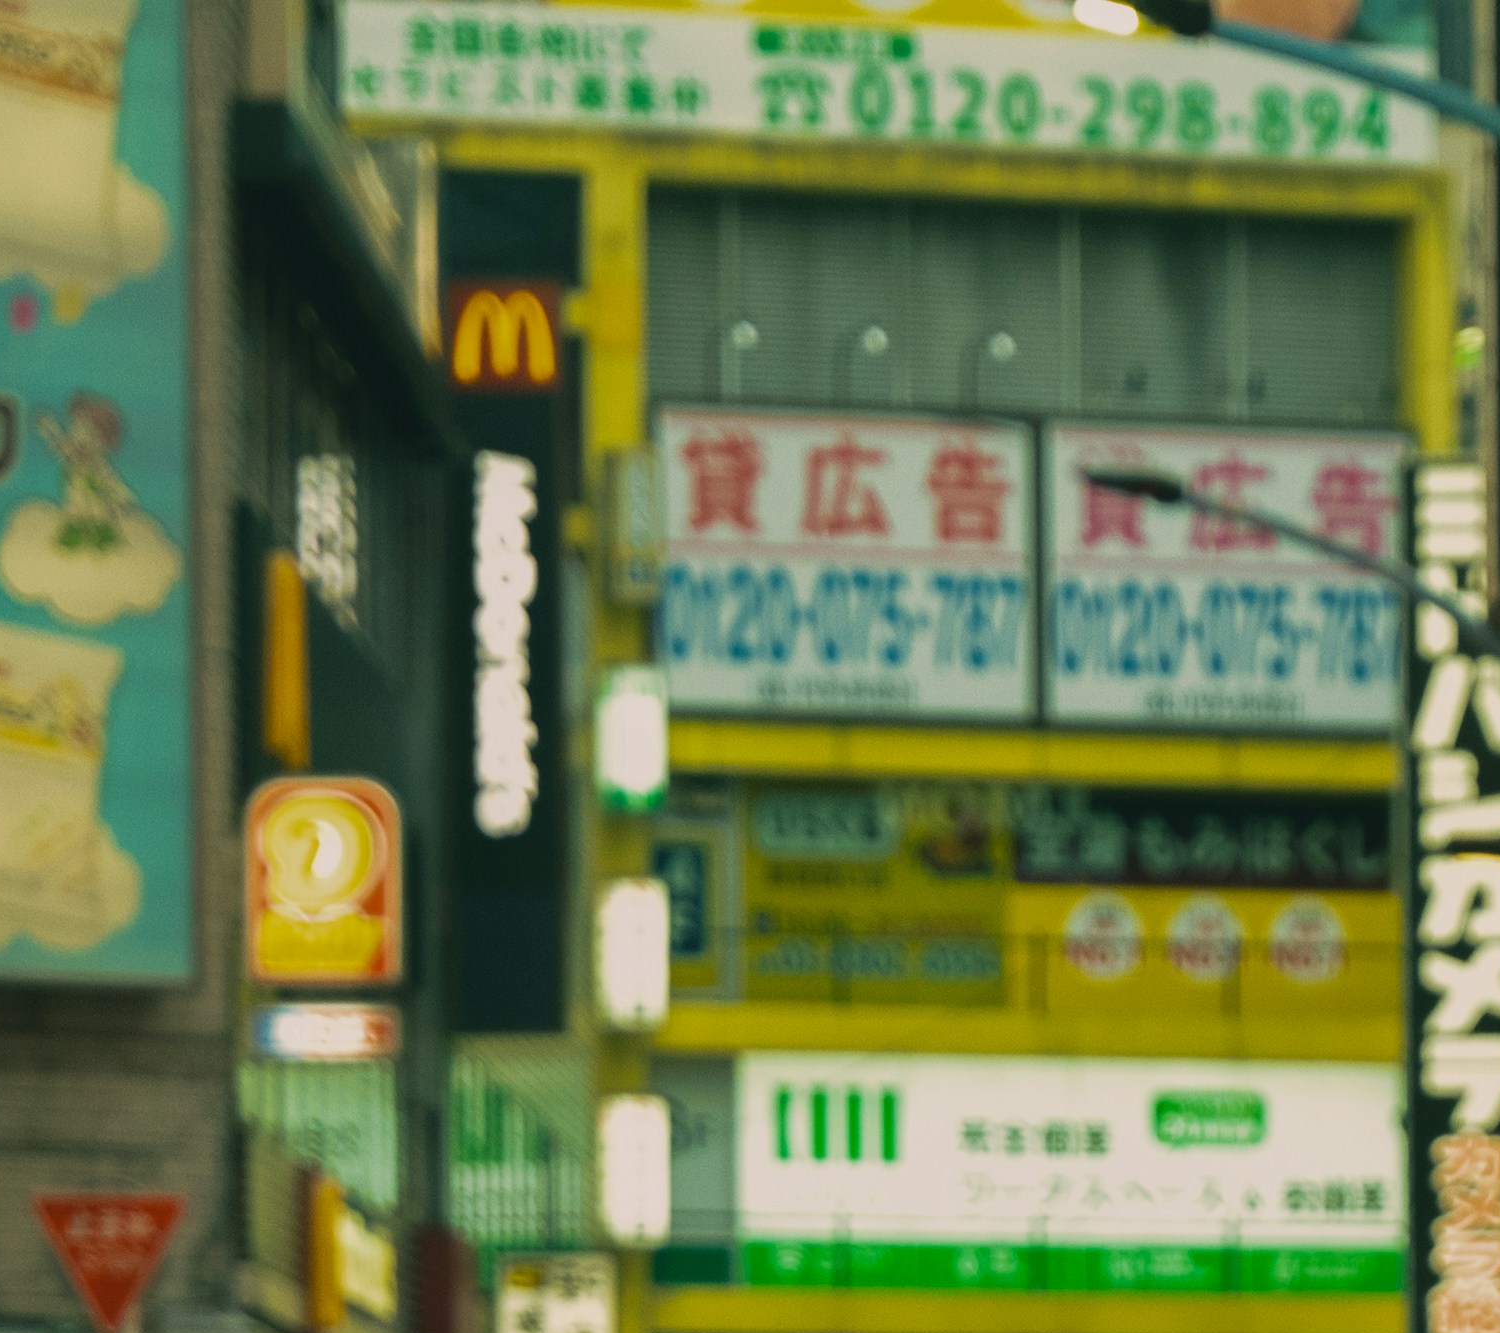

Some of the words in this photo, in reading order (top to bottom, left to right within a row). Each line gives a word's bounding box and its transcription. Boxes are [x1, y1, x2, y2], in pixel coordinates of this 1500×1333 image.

[847, 60, 1392, 152] 0120-298-894
[682, 428, 1010, 546] 貸広告
[1080, 445, 1400, 561] 貸広告
